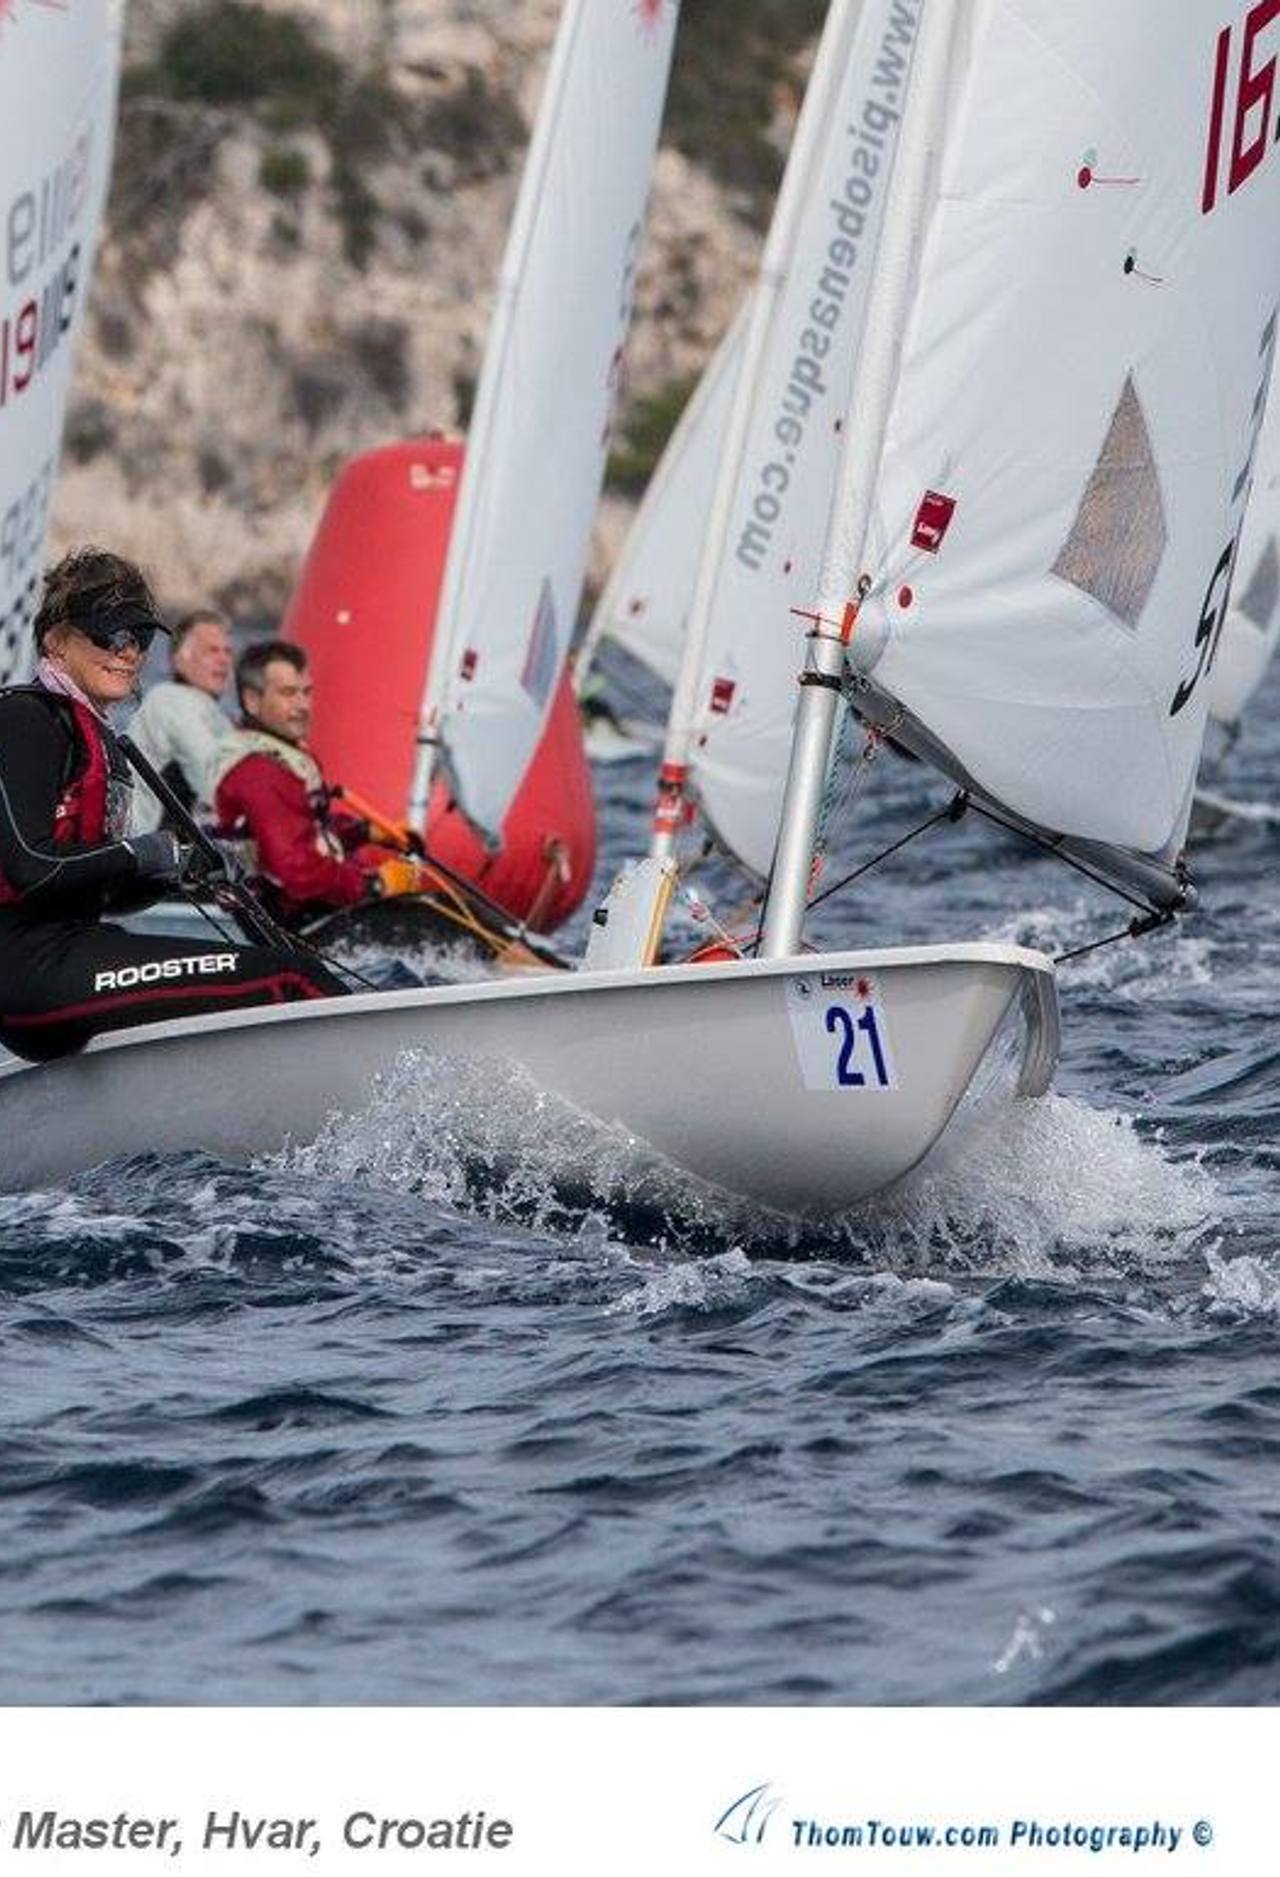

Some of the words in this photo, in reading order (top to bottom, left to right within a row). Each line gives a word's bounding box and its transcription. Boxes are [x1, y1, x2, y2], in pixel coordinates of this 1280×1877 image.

[1201, 0, 1280, 214] 16
[94, 953, 239, 992] ROOSTER
[826, 1006, 889, 1086] 21
